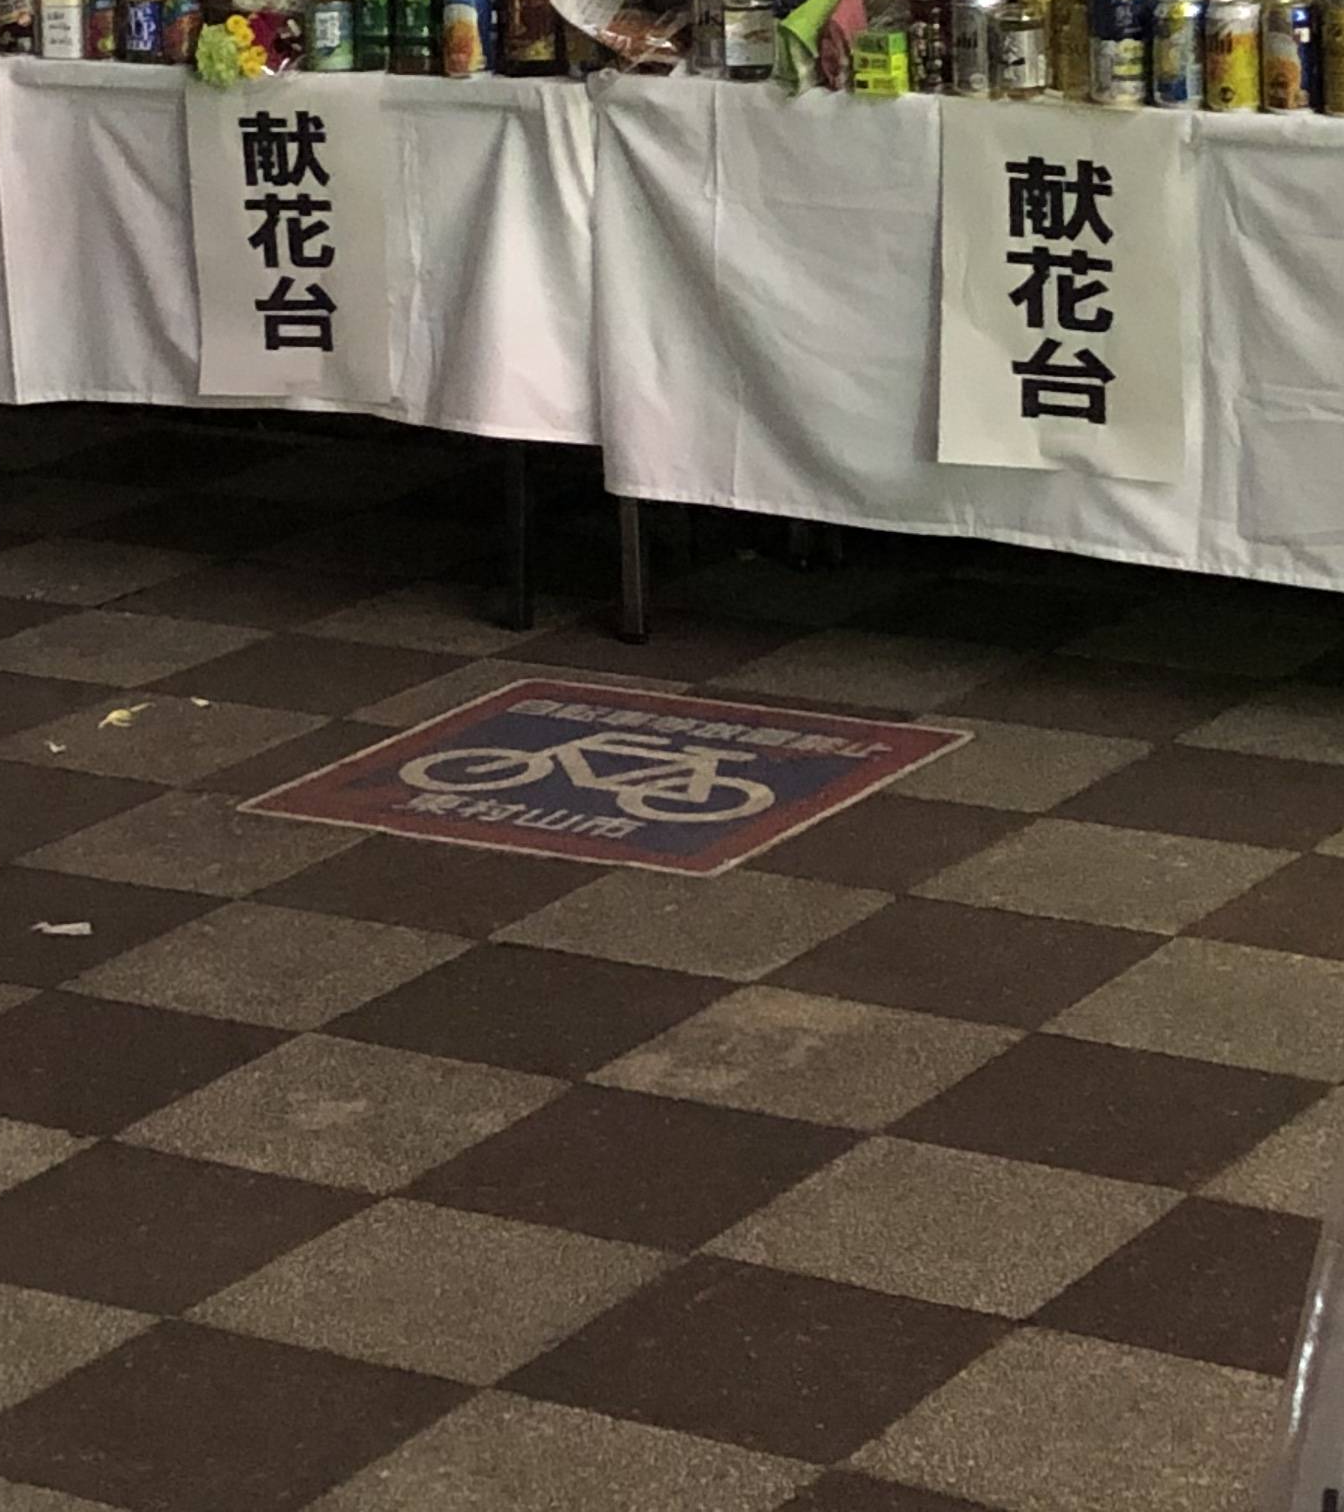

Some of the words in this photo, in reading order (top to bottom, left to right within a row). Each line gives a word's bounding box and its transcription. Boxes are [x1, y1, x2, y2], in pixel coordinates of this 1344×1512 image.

[238, 109, 338, 353] 献花台
[1004, 155, 1117, 426] 献花台
[391, 792, 649, 840] 東村山市
